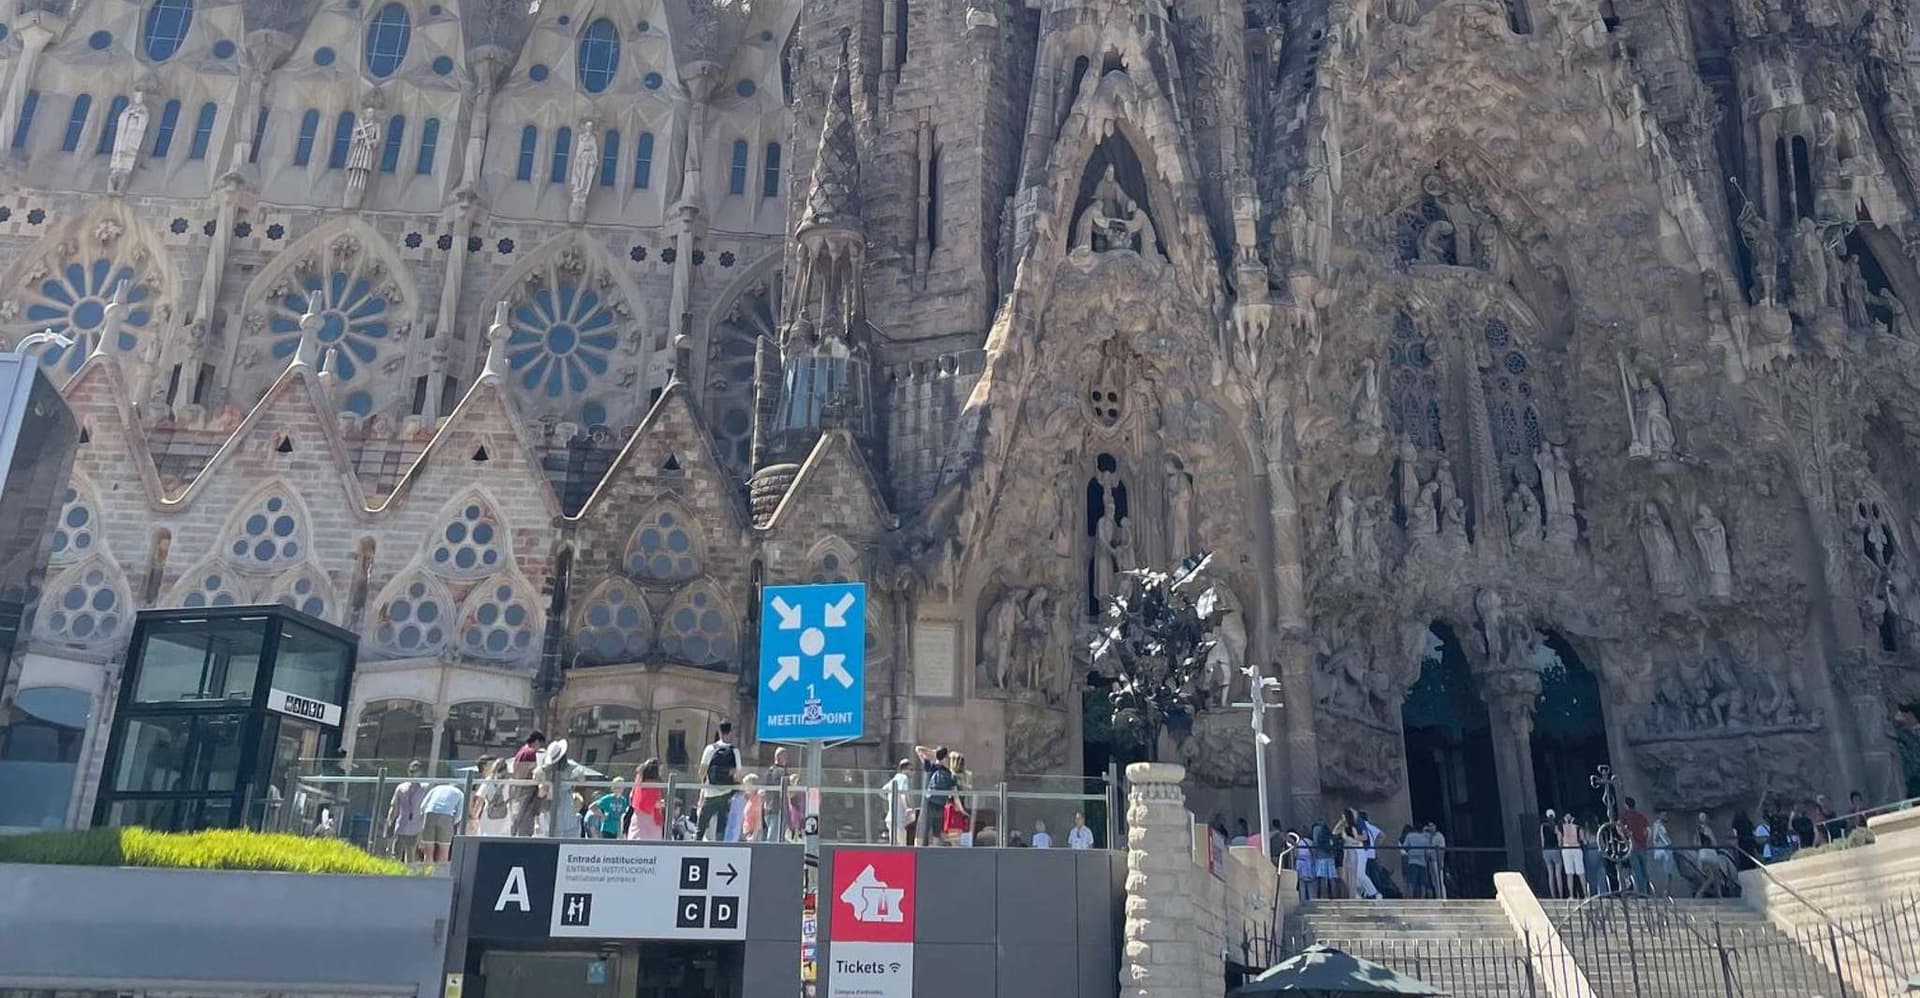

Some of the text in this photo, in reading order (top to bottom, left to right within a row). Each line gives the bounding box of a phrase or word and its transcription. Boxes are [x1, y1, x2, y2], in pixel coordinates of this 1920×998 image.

[807, 684, 815, 699] 1
[768, 714, 815, 727] MEETI
[820, 712, 853, 724] POINT
[567, 854, 657, 865] Entrada institucional
[566, 864, 601, 873] ENTRADA
[688, 865, 701, 882] B
[494, 866, 531, 911] A
[685, 903, 731, 921] C D
[836, 960, 885, 974] Tickets
